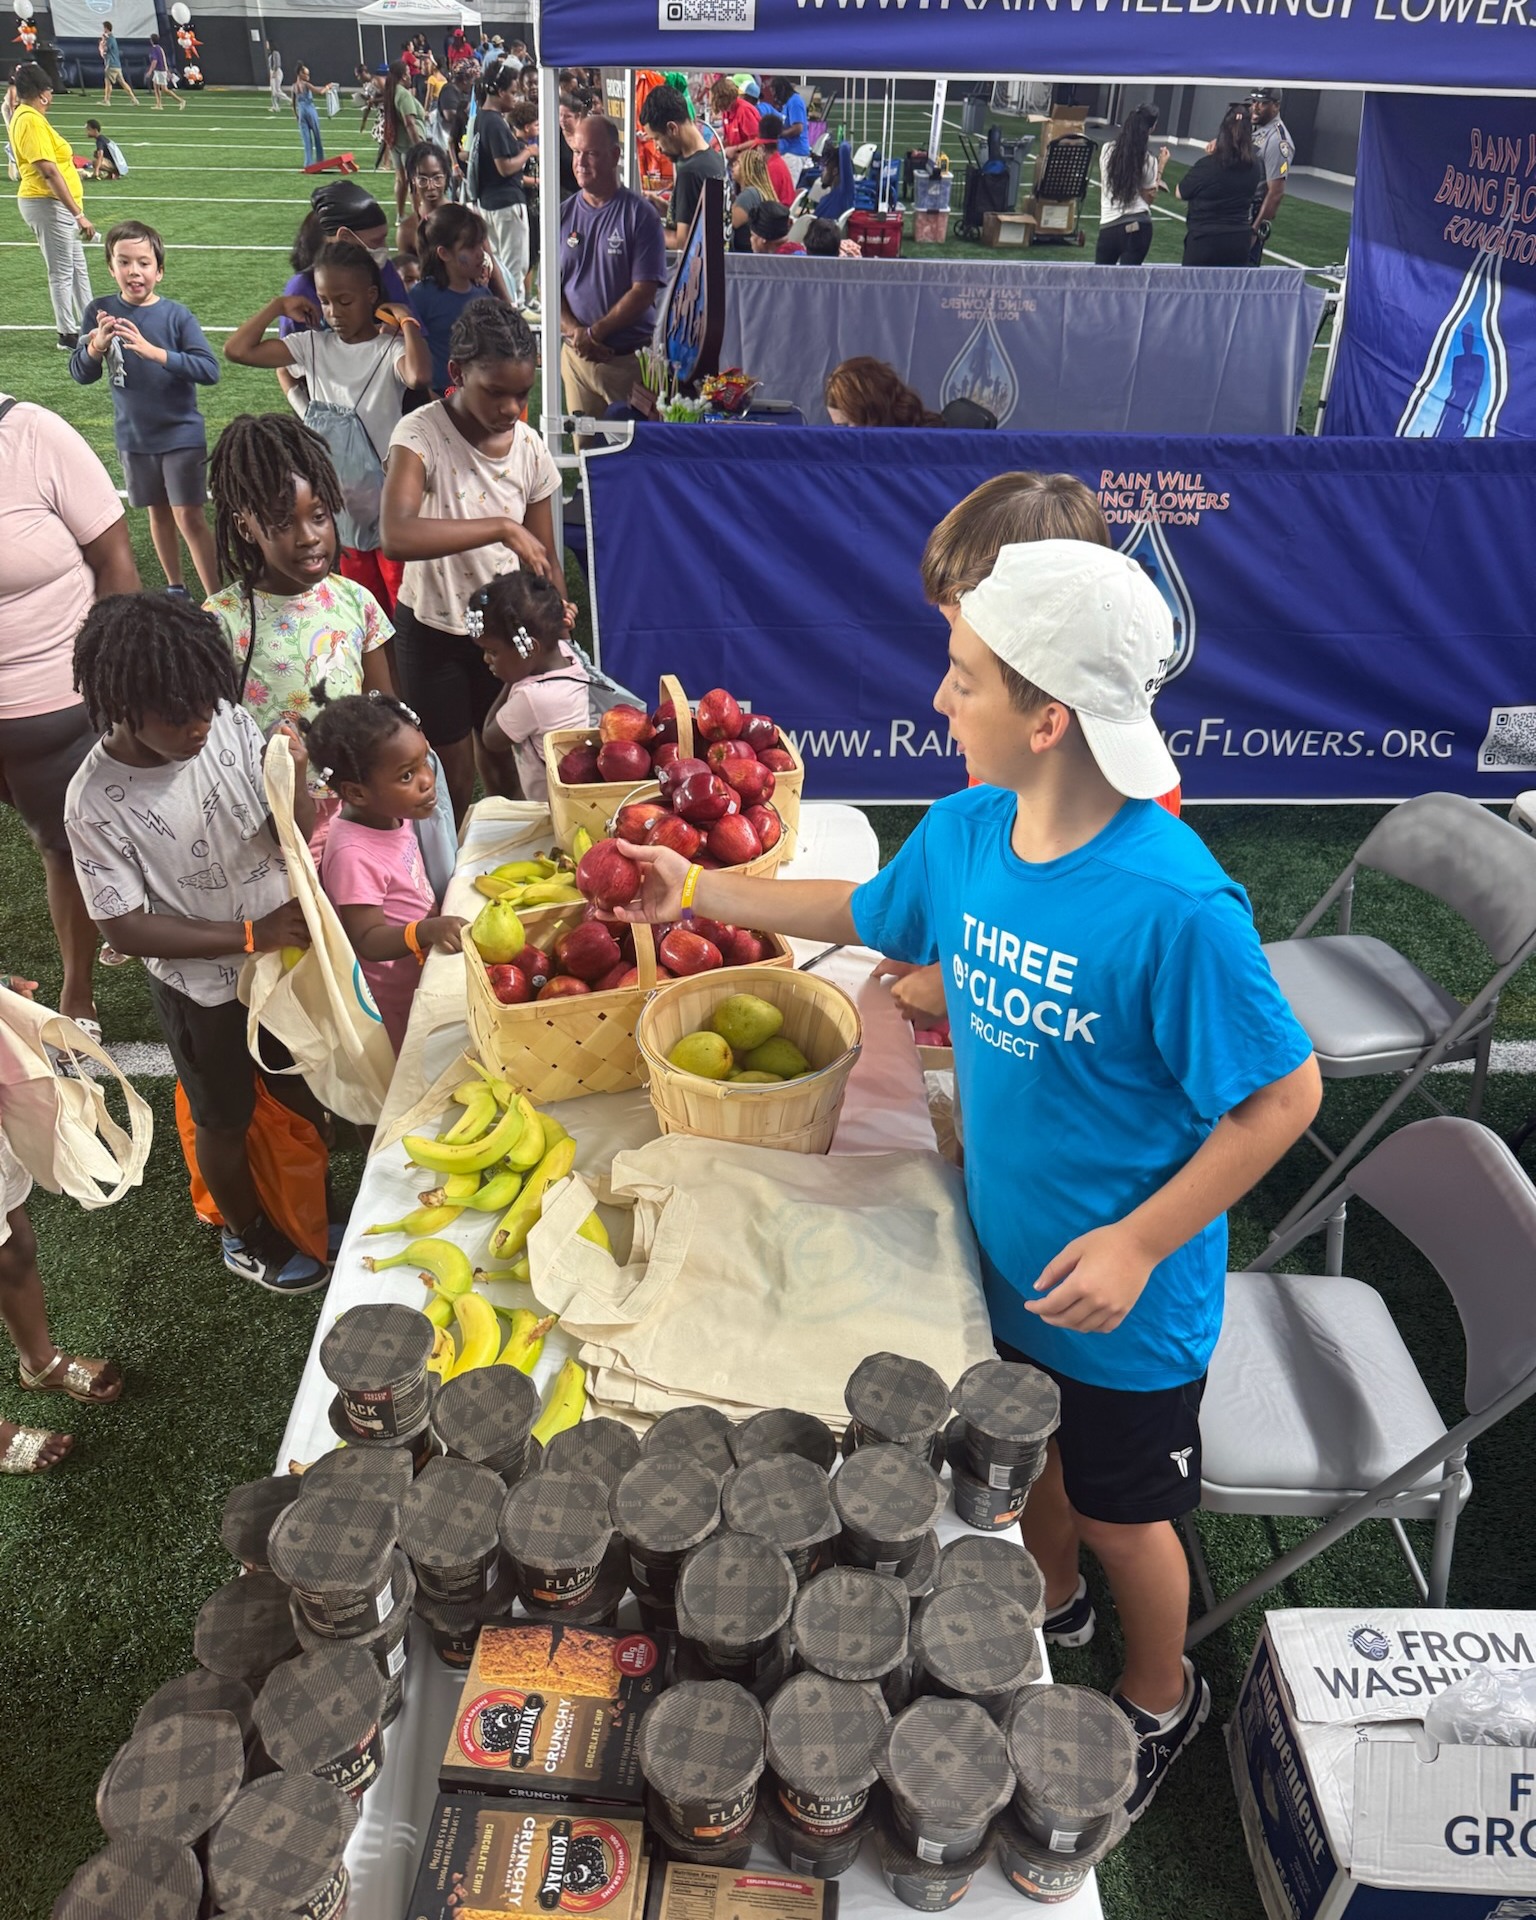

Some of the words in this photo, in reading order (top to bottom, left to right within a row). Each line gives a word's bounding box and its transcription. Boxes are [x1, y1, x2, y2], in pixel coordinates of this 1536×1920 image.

[1469, 128, 1521, 175] RAIN
[1434, 165, 1498, 215] BRING
[1444, 215, 1536, 266] FOUNDATIO
[1100, 469, 1151, 490] RAIN
[1157, 471, 1205, 491] WILL
[1097, 491, 1135, 509] ING
[1139, 489, 1230, 510] FLOWERS
[1103, 509, 1200, 526] OUNDATION
[962, 912, 1079, 995] THREE
[953, 953, 1102, 1045] O'CLOCK
[970, 1011, 1039, 1061] PROJECT
[621, 1647, 638, 1663] 10g
[1397, 1630, 1536, 1664] FROM
[928, 1703, 957, 1715] KODIAK
[514, 1706, 541, 1755] KODIAK
[544, 1697, 572, 1773] CRUNCHY
[584, 1724, 600, 1769] CHOCOLATE
[594, 1708, 605, 1726] CHIP
[1081, 1715, 1108, 1744] KODIAK
[329, 1747, 372, 1785] JACK
[976, 1755, 1008, 1766] KODIAK
[1258, 1660, 1326, 1866] Independent
[508, 1787, 569, 1802] CRUNCHY
[818, 1794, 850, 1802] KODIAK
[930, 1798, 962, 1810] KODIAK
[1082, 1780, 1106, 1802] KODIA
[477, 1823, 494, 1873] CHOCOLATE
[508, 1816, 536, 1907] CRUNCHY
[615, 1844, 626, 1873] WHOLE
[267, 1861, 301, 1884] KODIAK
[542, 1834, 569, 1895] KODIAK
[472, 1872, 484, 1895] CHIP
[601, 1871, 624, 1899] GRAINS
[704, 1889, 716, 1897] 210
